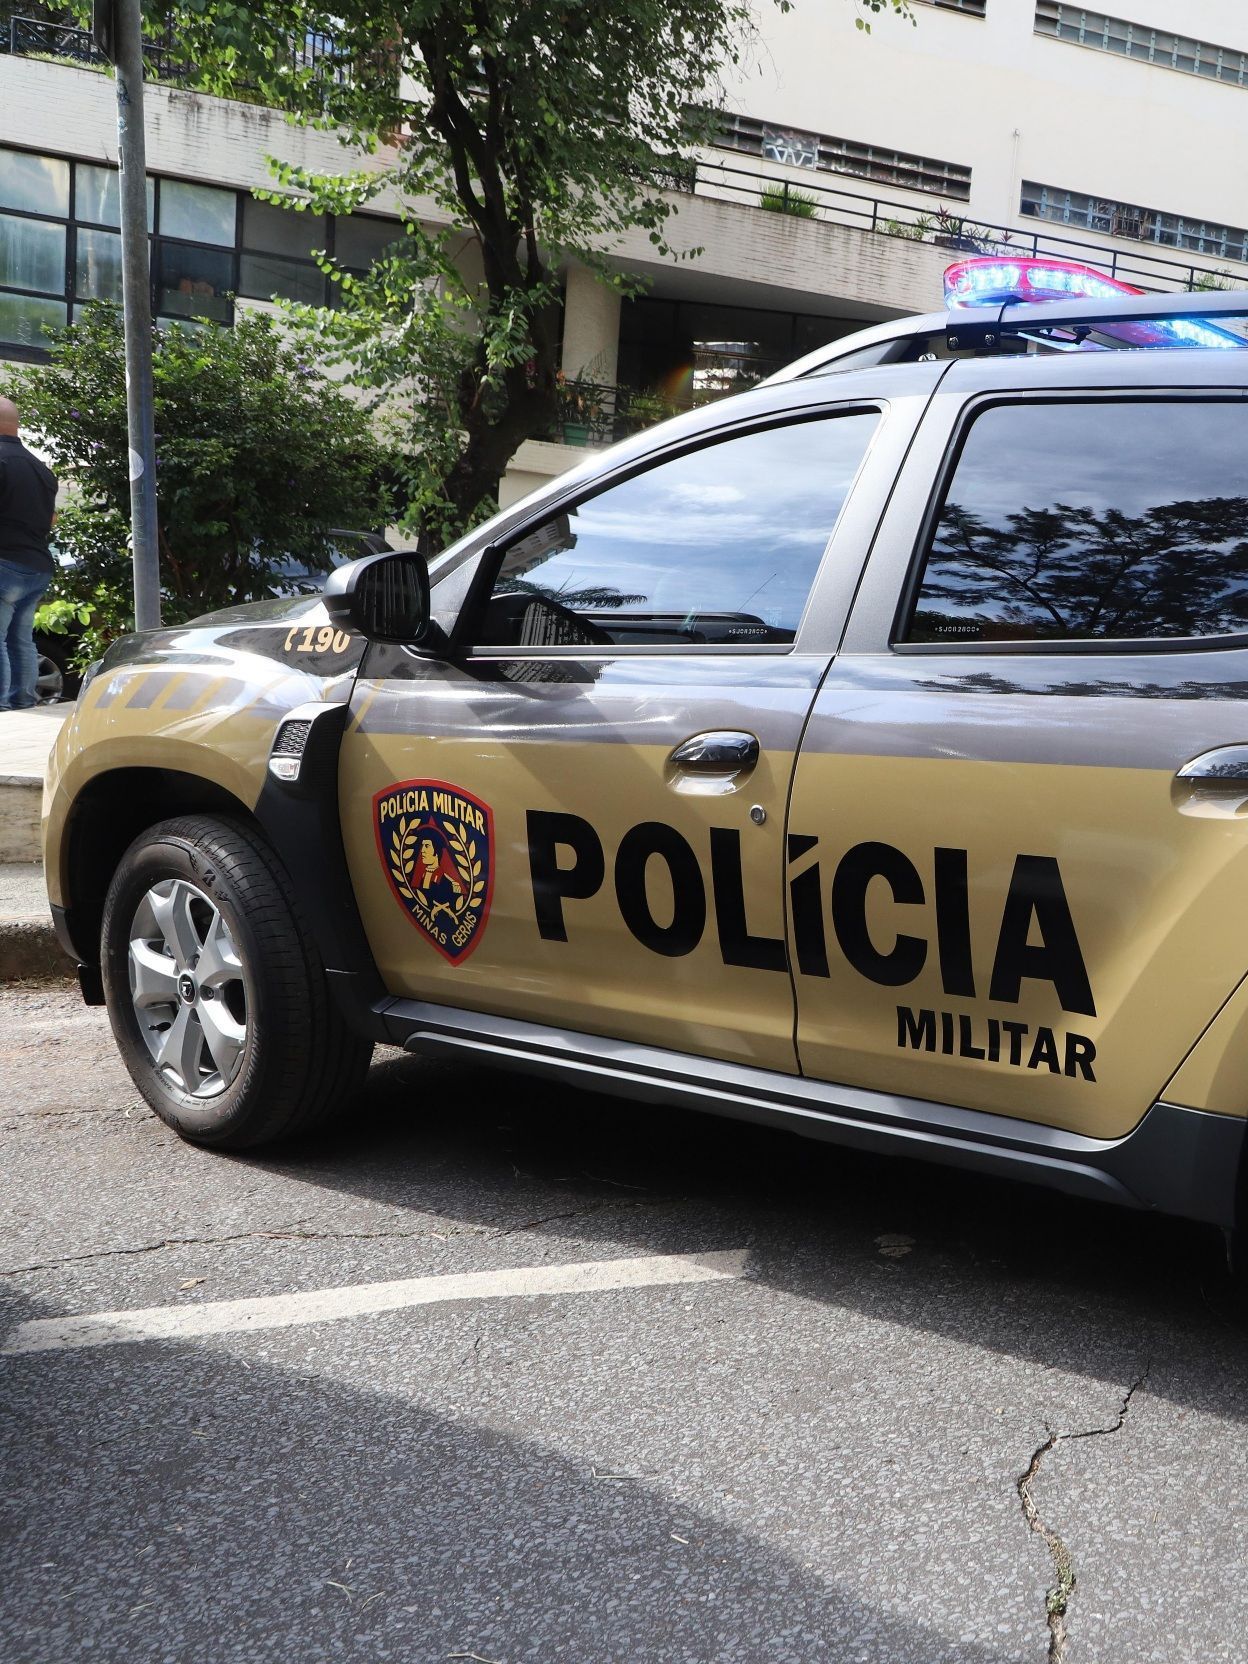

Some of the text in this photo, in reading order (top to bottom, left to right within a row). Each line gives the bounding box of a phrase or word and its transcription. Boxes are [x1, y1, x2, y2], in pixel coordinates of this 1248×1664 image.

[296, 626, 351, 653] 190
[380, 790, 486, 835] POLÍCIA MILITAR
[411, 904, 477, 948] MINAS GERAIS
[525, 809, 1097, 1018] POLÍCIA
[896, 1005, 1097, 1083] MILITAR
